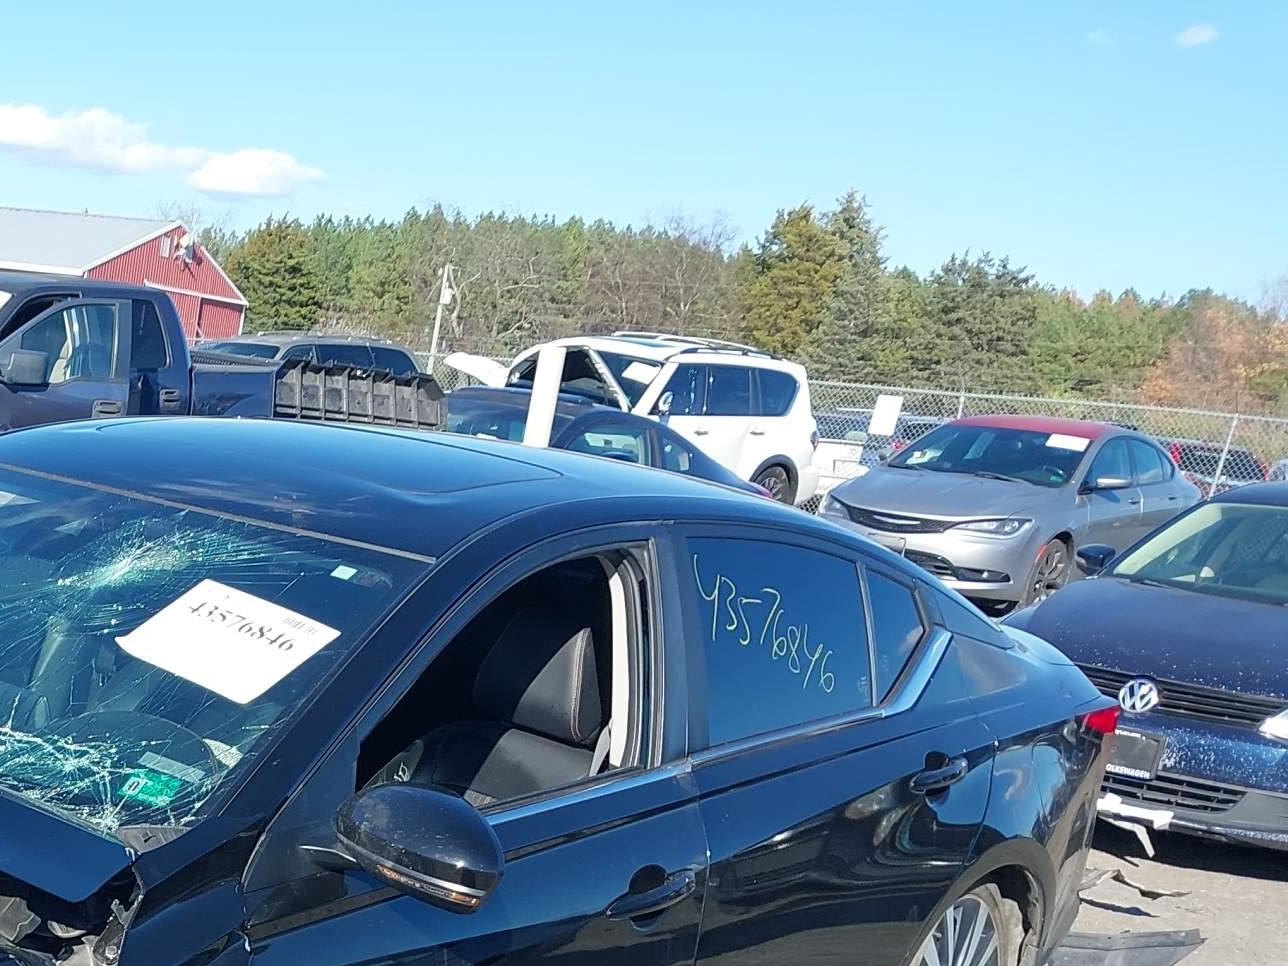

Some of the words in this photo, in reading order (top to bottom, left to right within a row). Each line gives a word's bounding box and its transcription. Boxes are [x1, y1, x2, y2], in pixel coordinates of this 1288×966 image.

[188, 601, 295, 652] 43576846
[693, 553, 835, 693] 43576846
[1105, 763, 1151, 780] OLKSWAGEN
